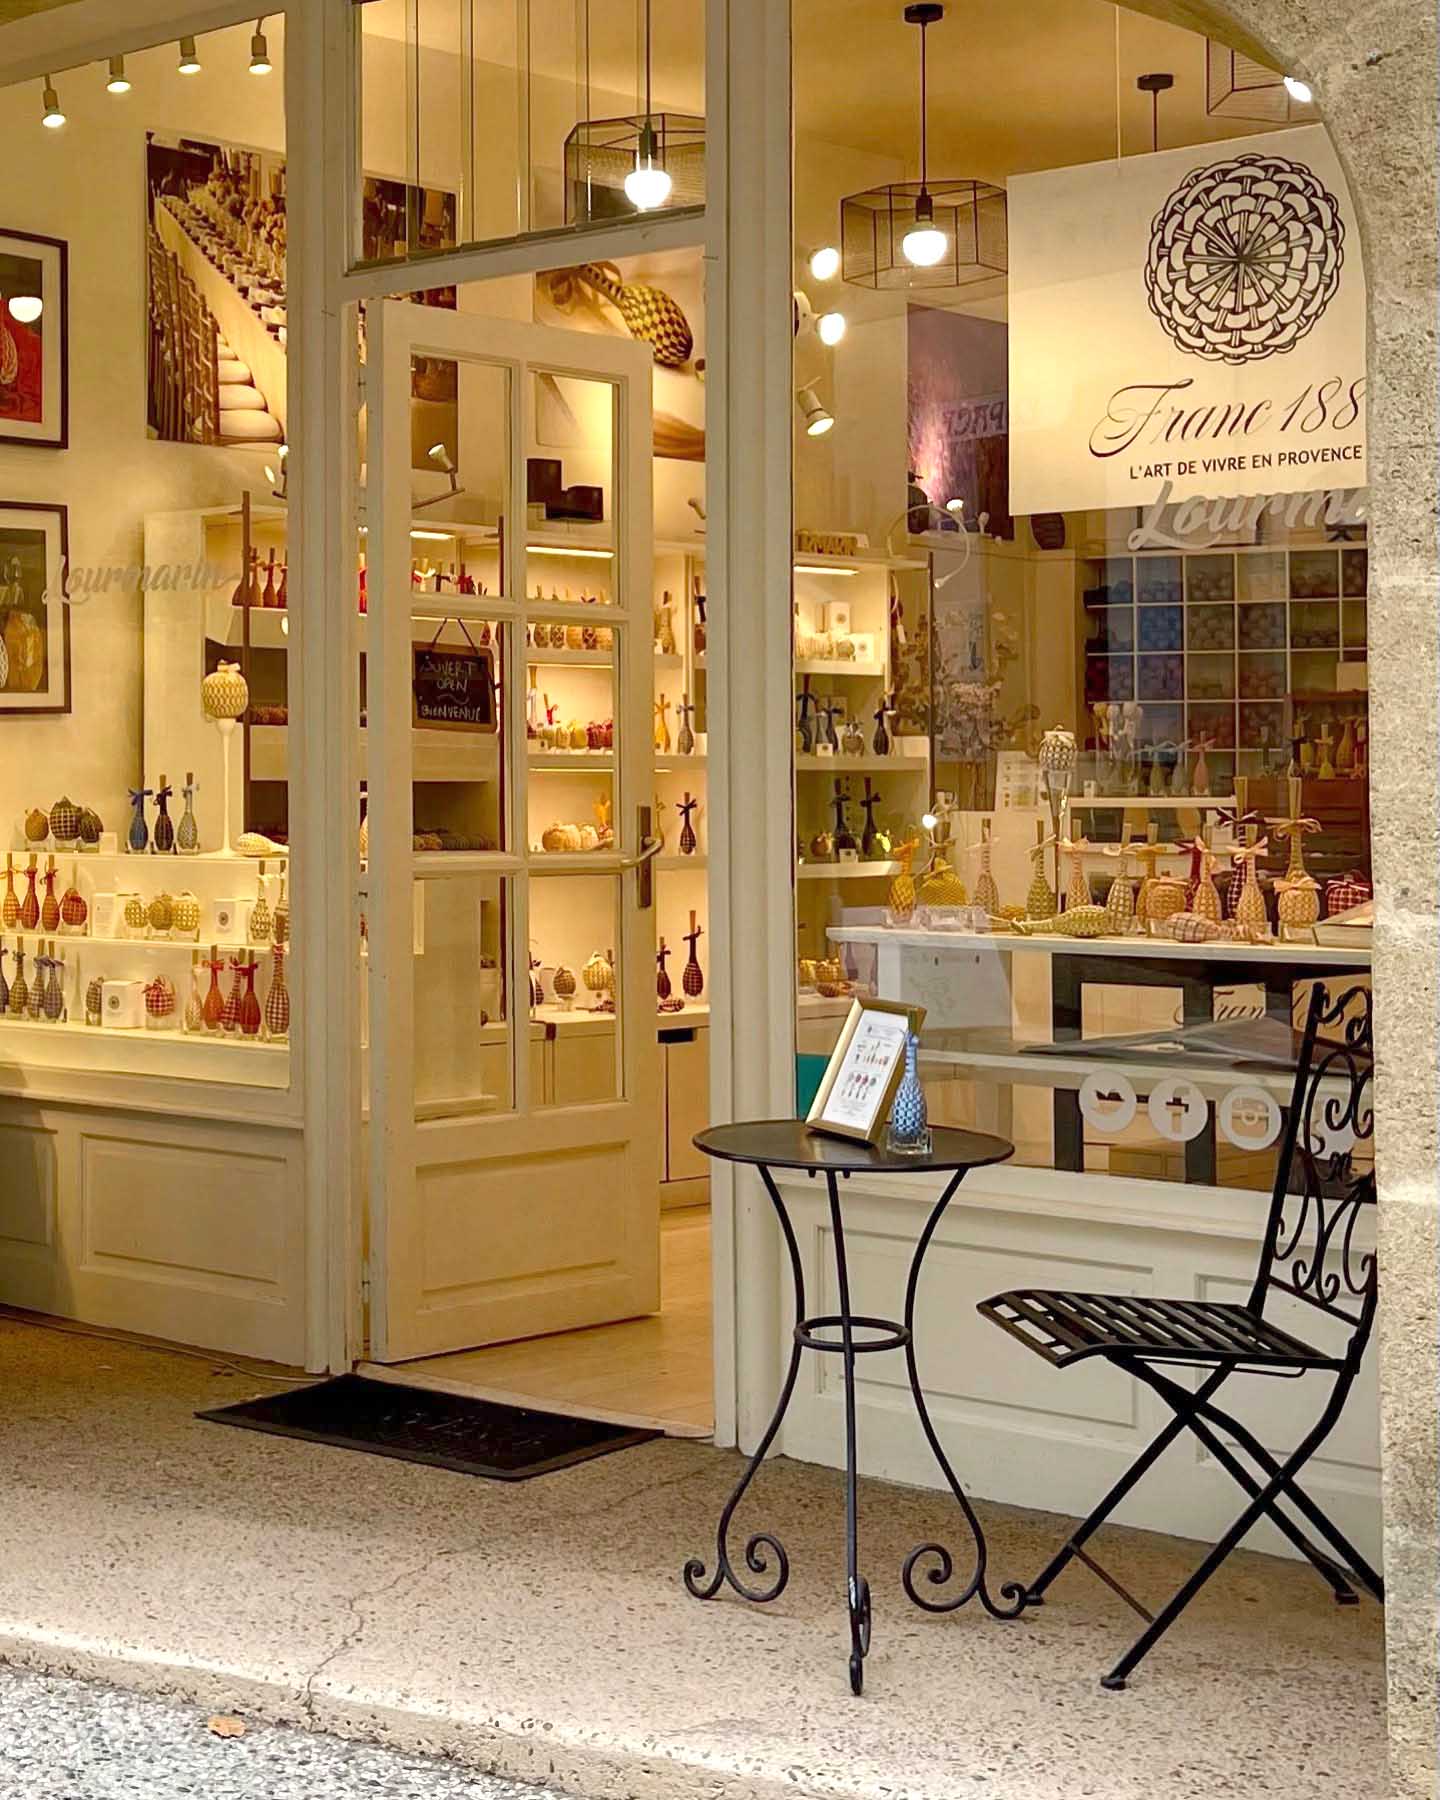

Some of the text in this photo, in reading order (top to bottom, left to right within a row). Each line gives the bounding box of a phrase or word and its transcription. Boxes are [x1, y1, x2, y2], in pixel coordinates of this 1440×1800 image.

[1089, 378, 1272, 457] Franc
[1129, 445, 1363, 479] L'ART DE VIVRE EN PROVENCE
[41, 555, 241, 605] Lourmarin
[436, 676, 468, 693] OPEN
